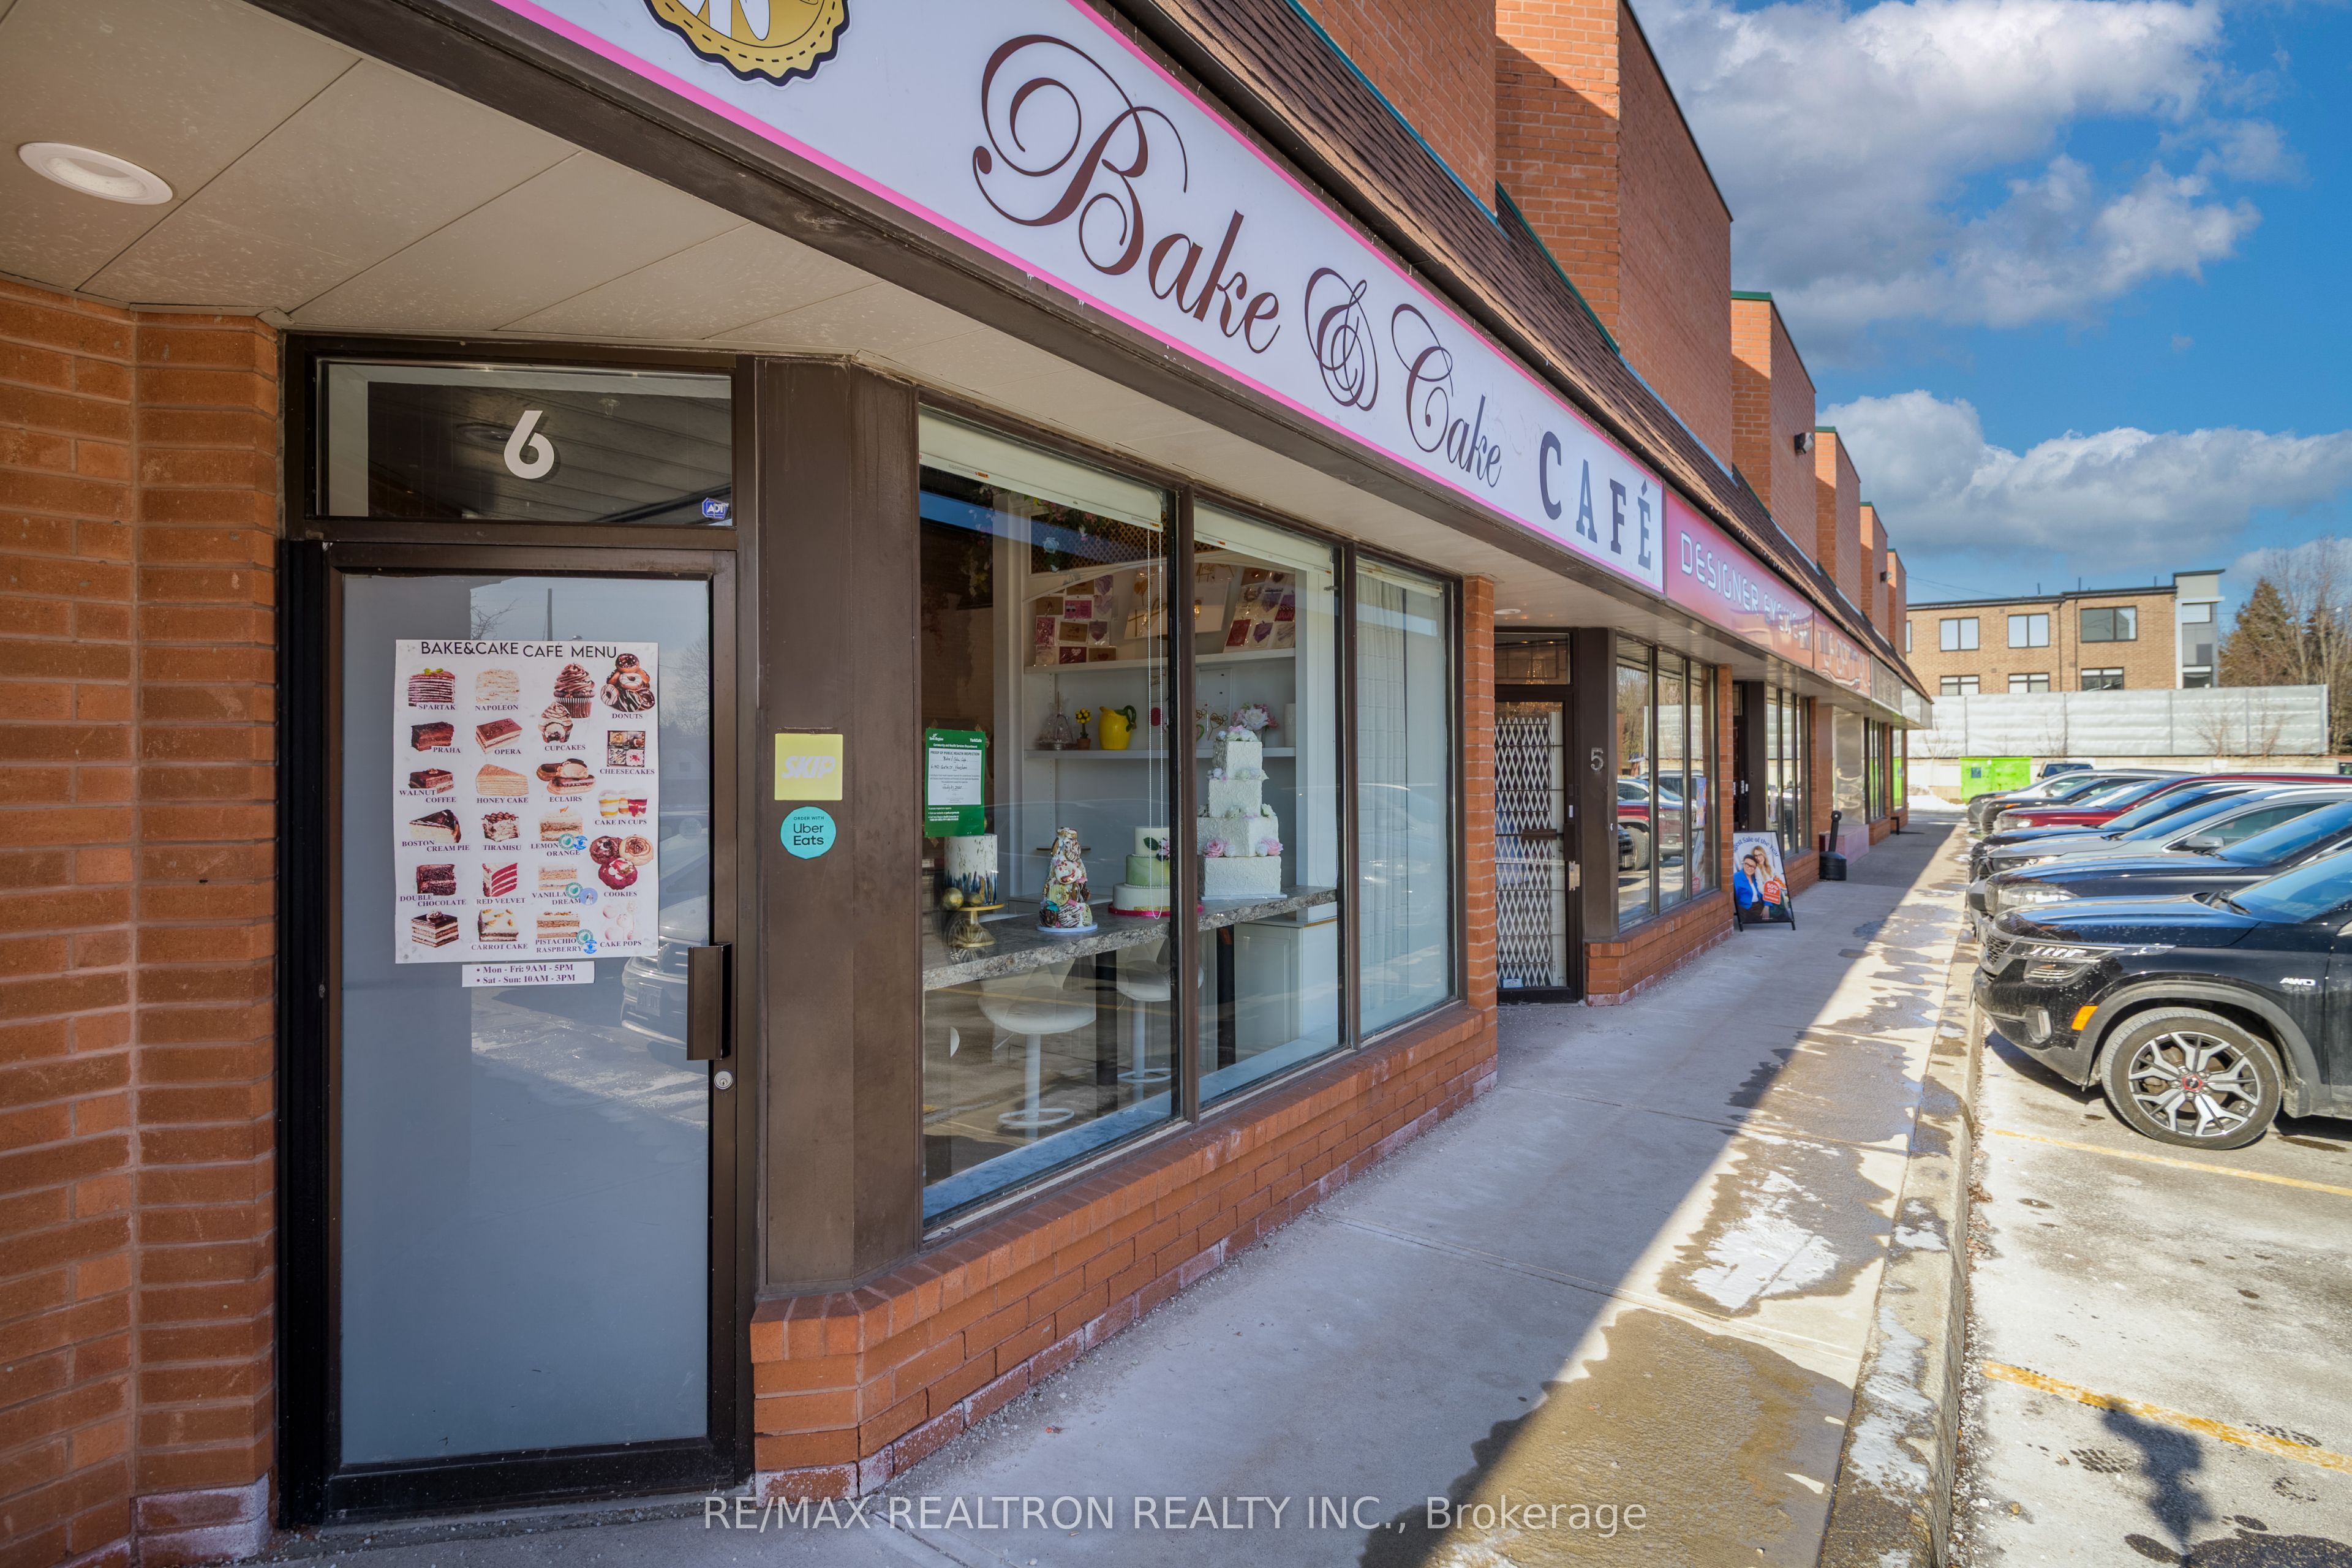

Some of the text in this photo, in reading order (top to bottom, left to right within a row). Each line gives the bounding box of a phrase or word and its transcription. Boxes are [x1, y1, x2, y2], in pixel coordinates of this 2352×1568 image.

[973, 33, 1280, 353] Bake
[1391, 303, 1502, 487] Cake
[1539, 431, 1651, 570] CAFÉ
[504, 410, 554, 479] 6
[707, 503, 724, 513] ADT
[1681, 531, 1759, 616] DESIGNER
[421, 641, 519, 655] BAKE&CAKE
[571, 646, 617, 658] MENU
[781, 755, 836, 779] SKIP
[1591, 747, 1604, 771] 5
[793, 823, 824, 833] Uber
[793, 835, 824, 846] Eats
[1761, 837, 1770, 846] the
[2279, 977, 2316, 986] AWD
